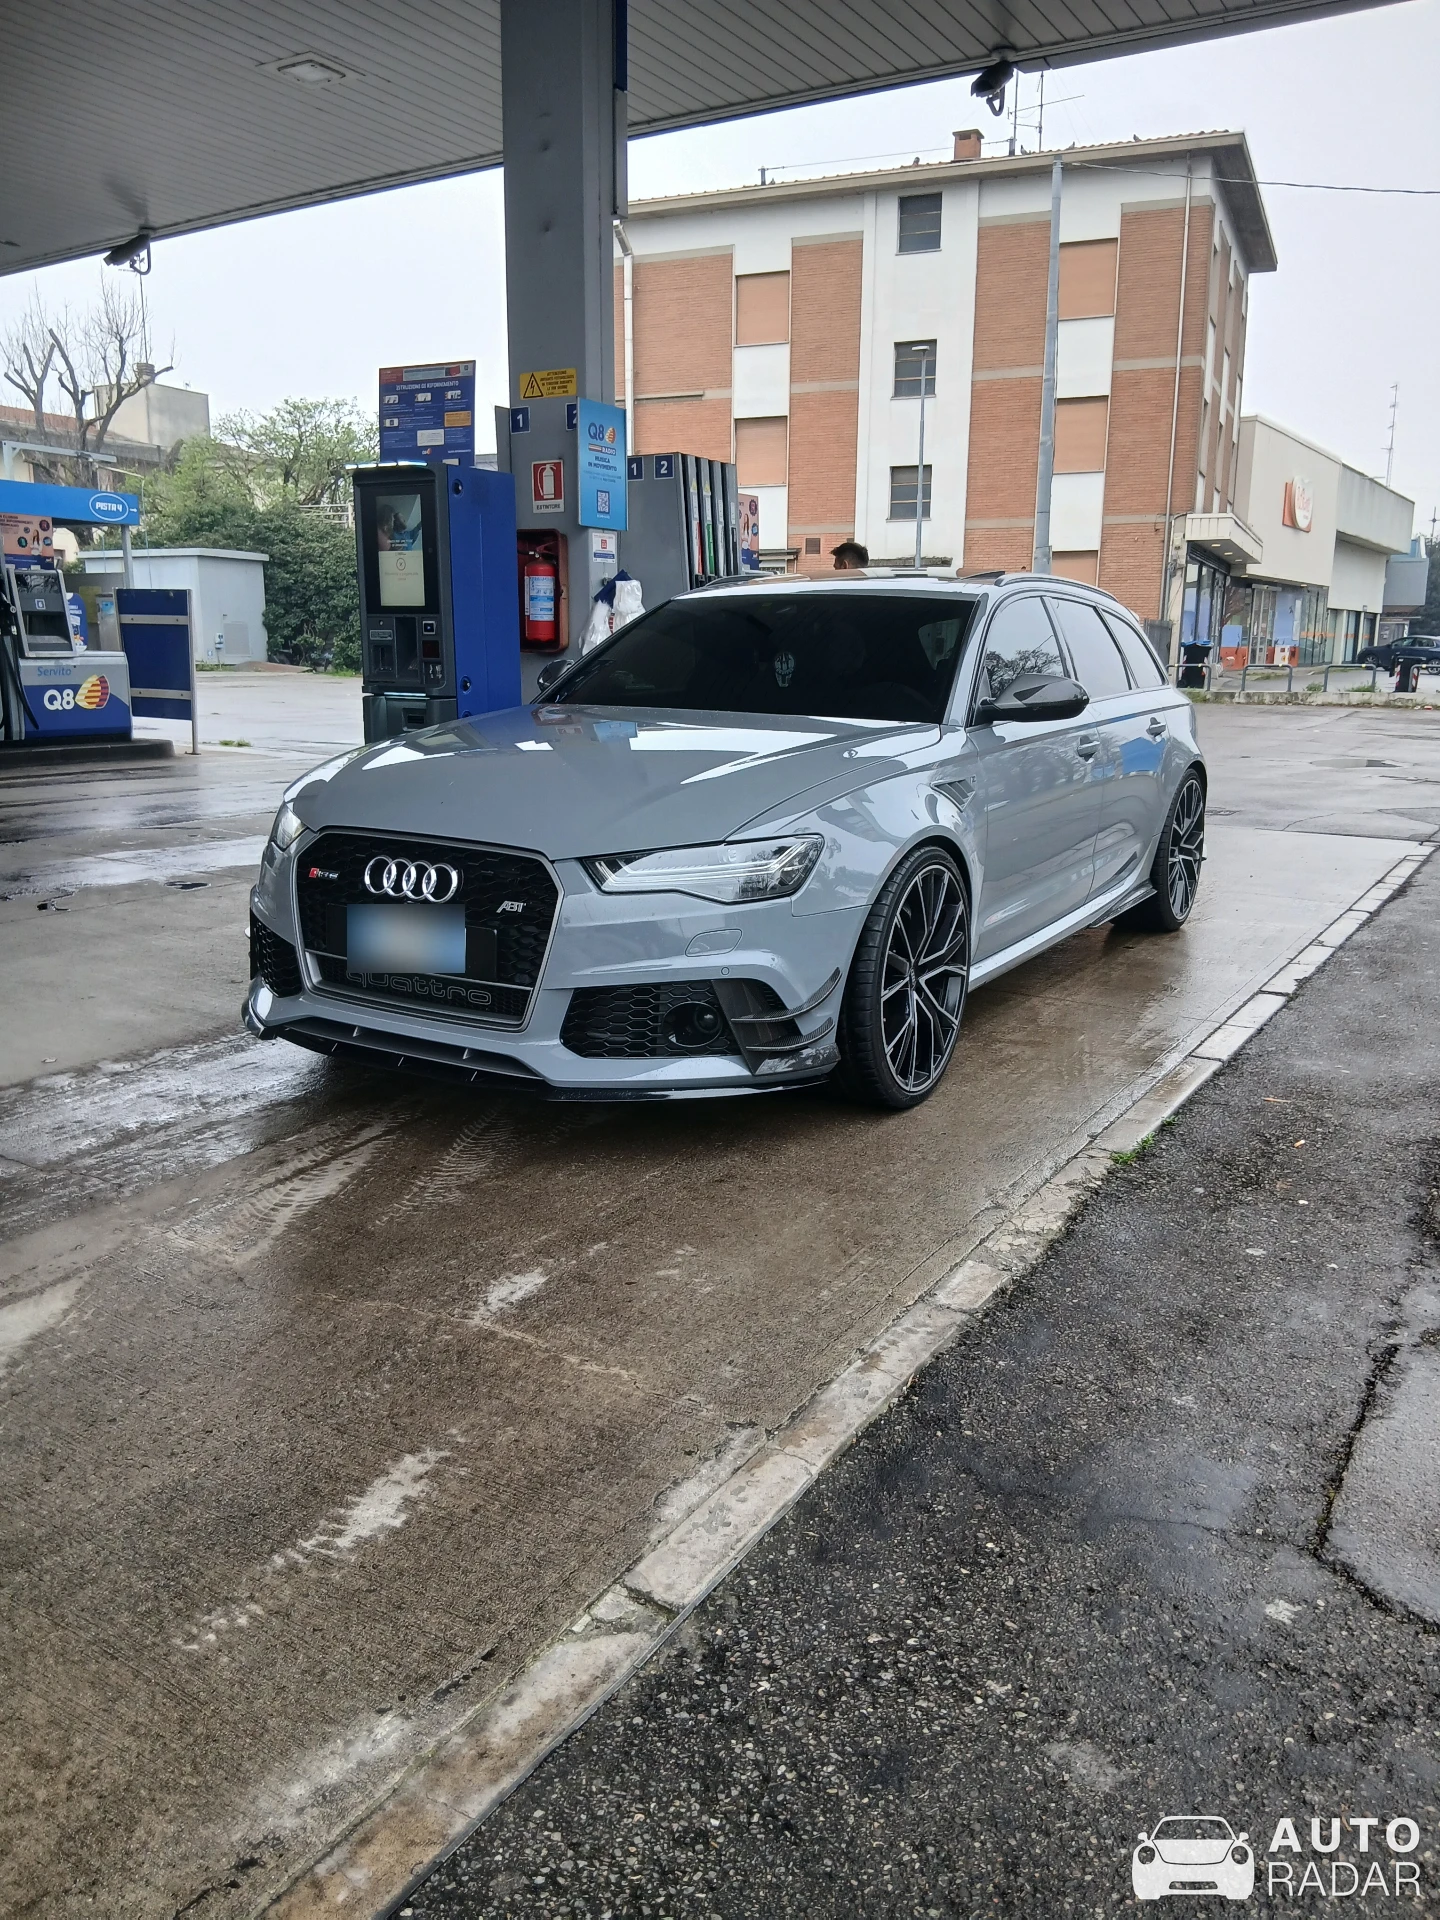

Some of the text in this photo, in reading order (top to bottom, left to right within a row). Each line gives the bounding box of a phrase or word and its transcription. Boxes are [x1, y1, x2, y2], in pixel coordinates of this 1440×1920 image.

[427, 380, 459, 389] RIFORNIMENTO
[517, 413, 523, 428] 1
[588, 422, 604, 441] Q8
[602, 447, 616, 455] RADIO
[595, 456, 611, 464] MUSICA
[593, 463, 617, 472] MOVIMENTO
[631, 463, 637, 476] 1
[660, 460, 668, 474] 2
[95, 501, 117, 512] PISTA
[536, 503, 561, 511] ESTINTORE
[37, 666, 72, 677] Servito
[43, 688, 75, 711] Q8
[496, 901, 523, 914] ABT
[346, 973, 492, 1006] quattro
